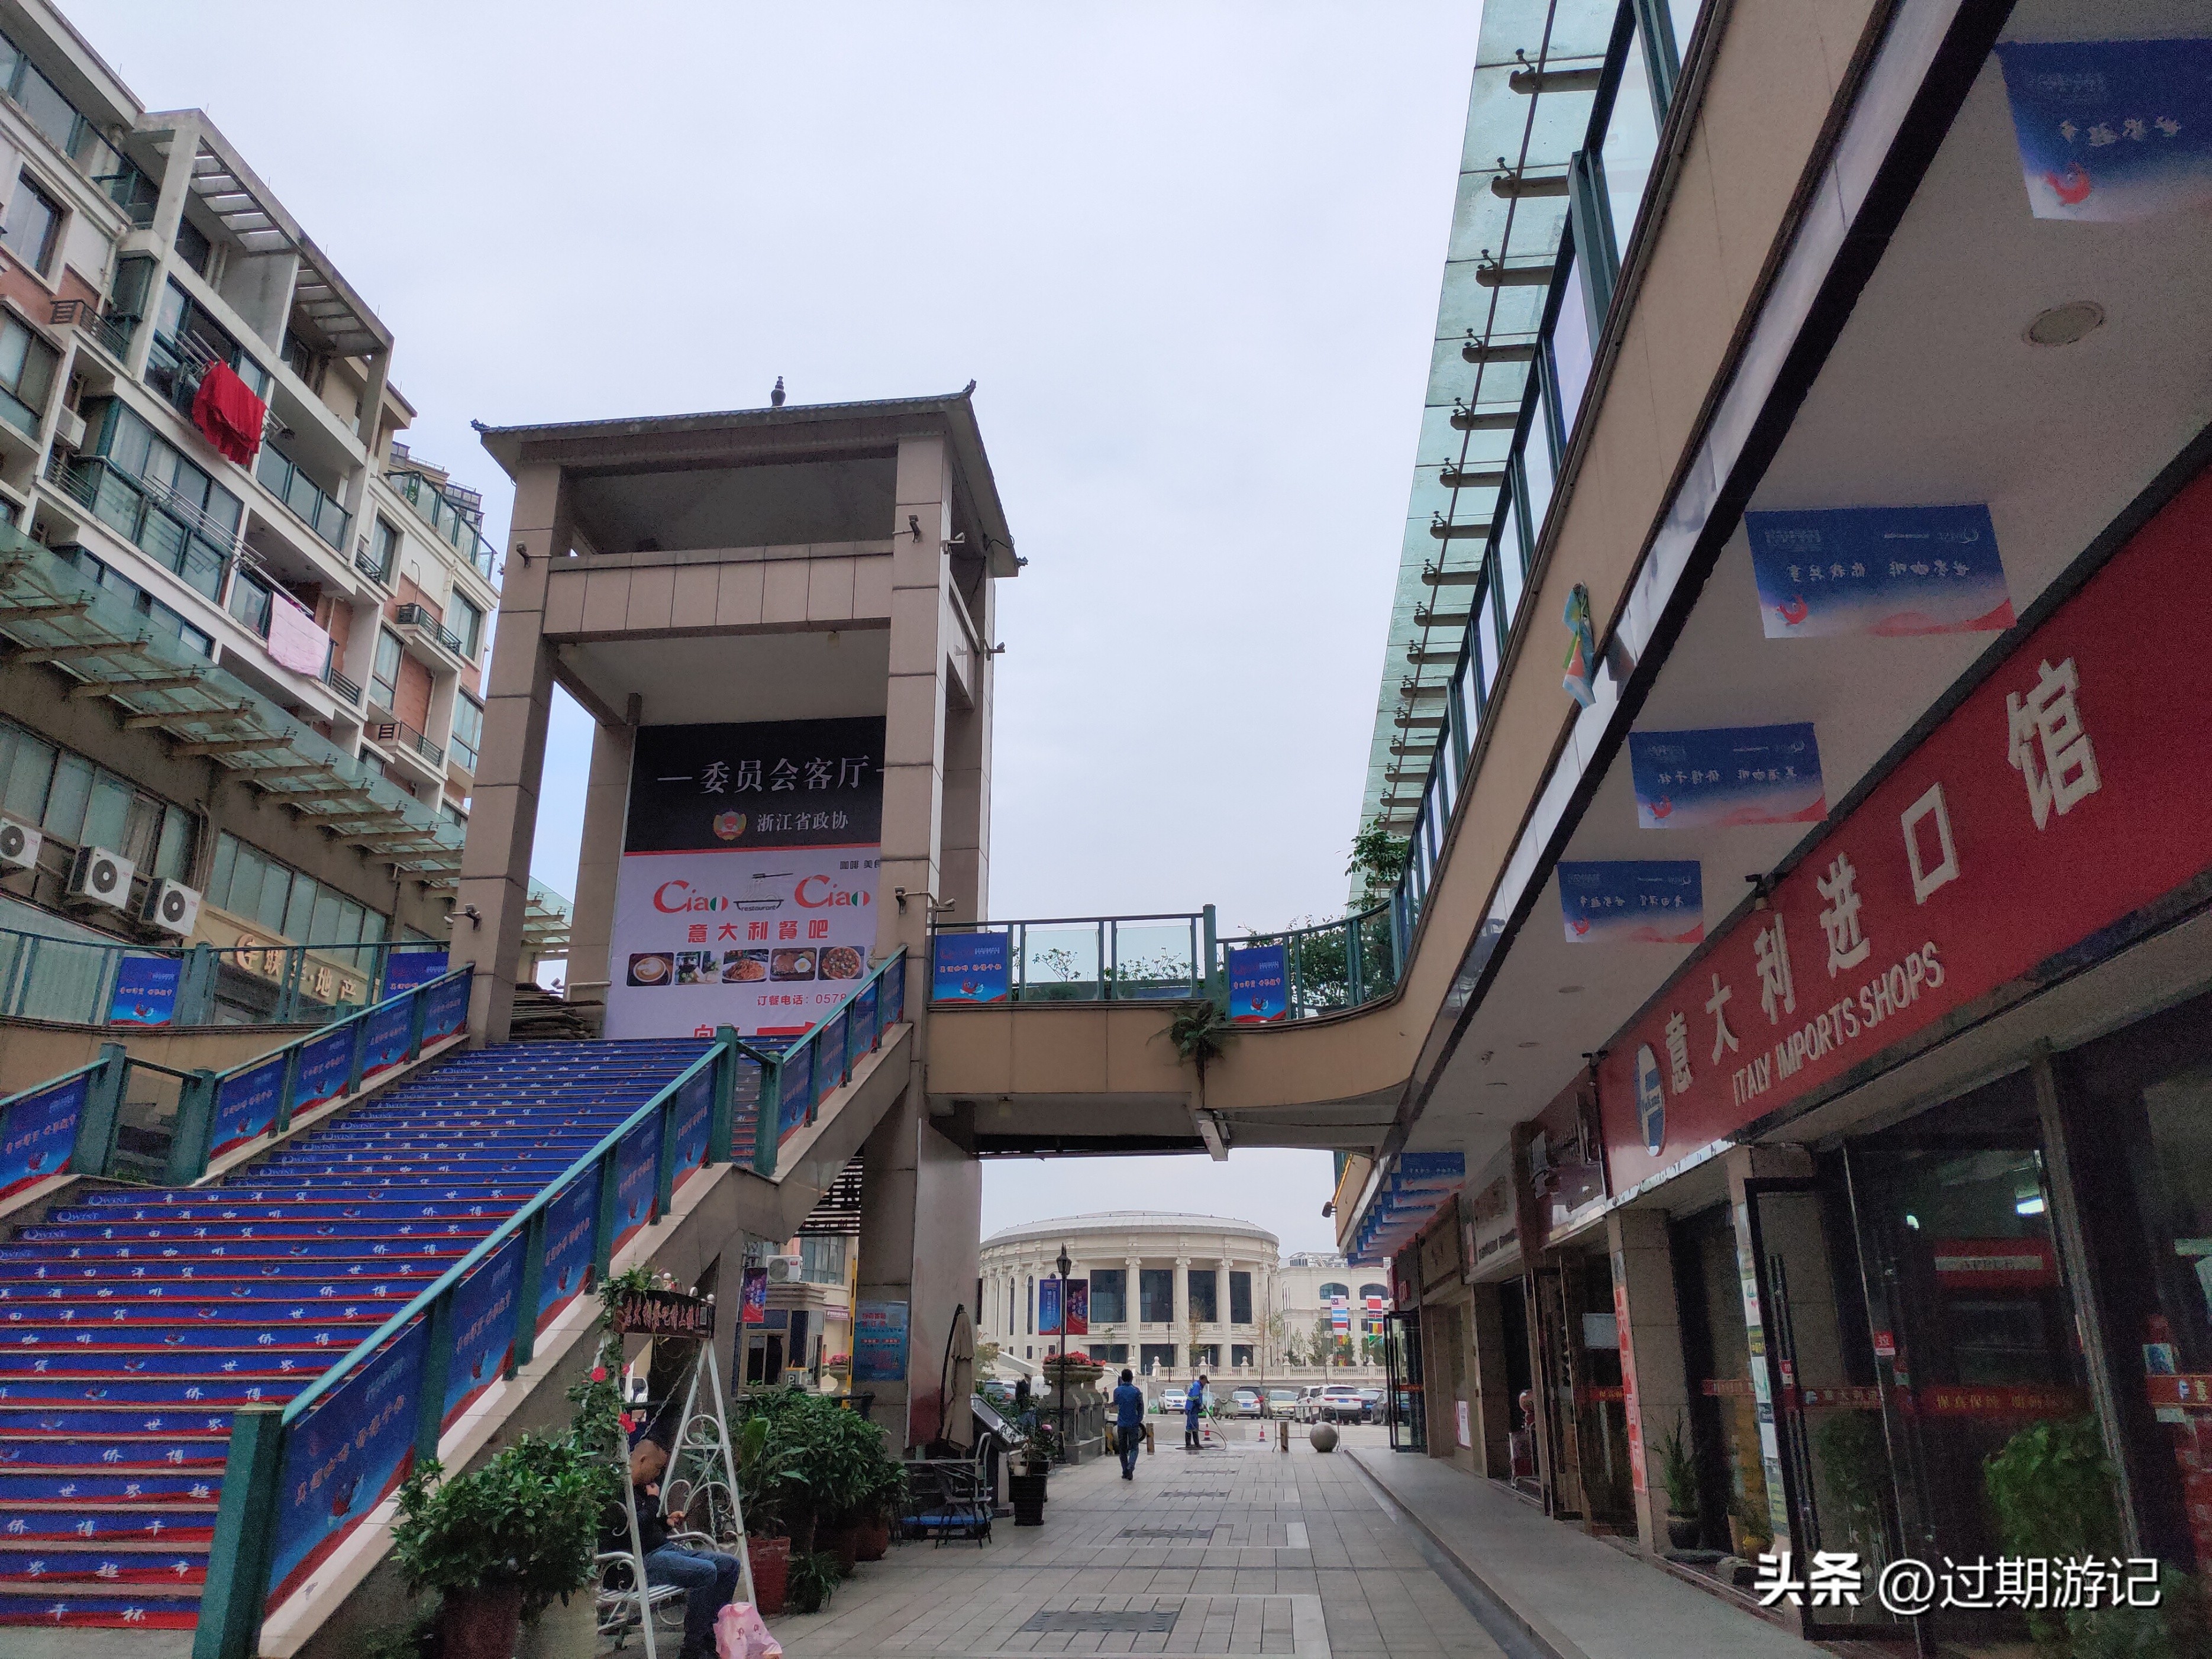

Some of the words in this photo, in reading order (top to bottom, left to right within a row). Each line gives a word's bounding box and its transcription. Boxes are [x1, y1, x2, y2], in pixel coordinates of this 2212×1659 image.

[699, 755, 870, 794] 委员会客厅
[757, 811, 849, 832] 浙江省政协
[839, 860, 859, 870] 咖啡
[1666, 657, 2102, 1095] 意大利进口馆
[653, 880, 728, 914] Ciao
[794, 874, 871, 909] Ciao
[687, 919, 828, 944] 意大利餐吧
[1733, 1053, 1773, 1106] ITALY
[1777, 999, 1860, 1081] IMPORTS
[1861, 942, 1945, 1028] SHOPS
[47, 1603, 147, 1623] 干杯
